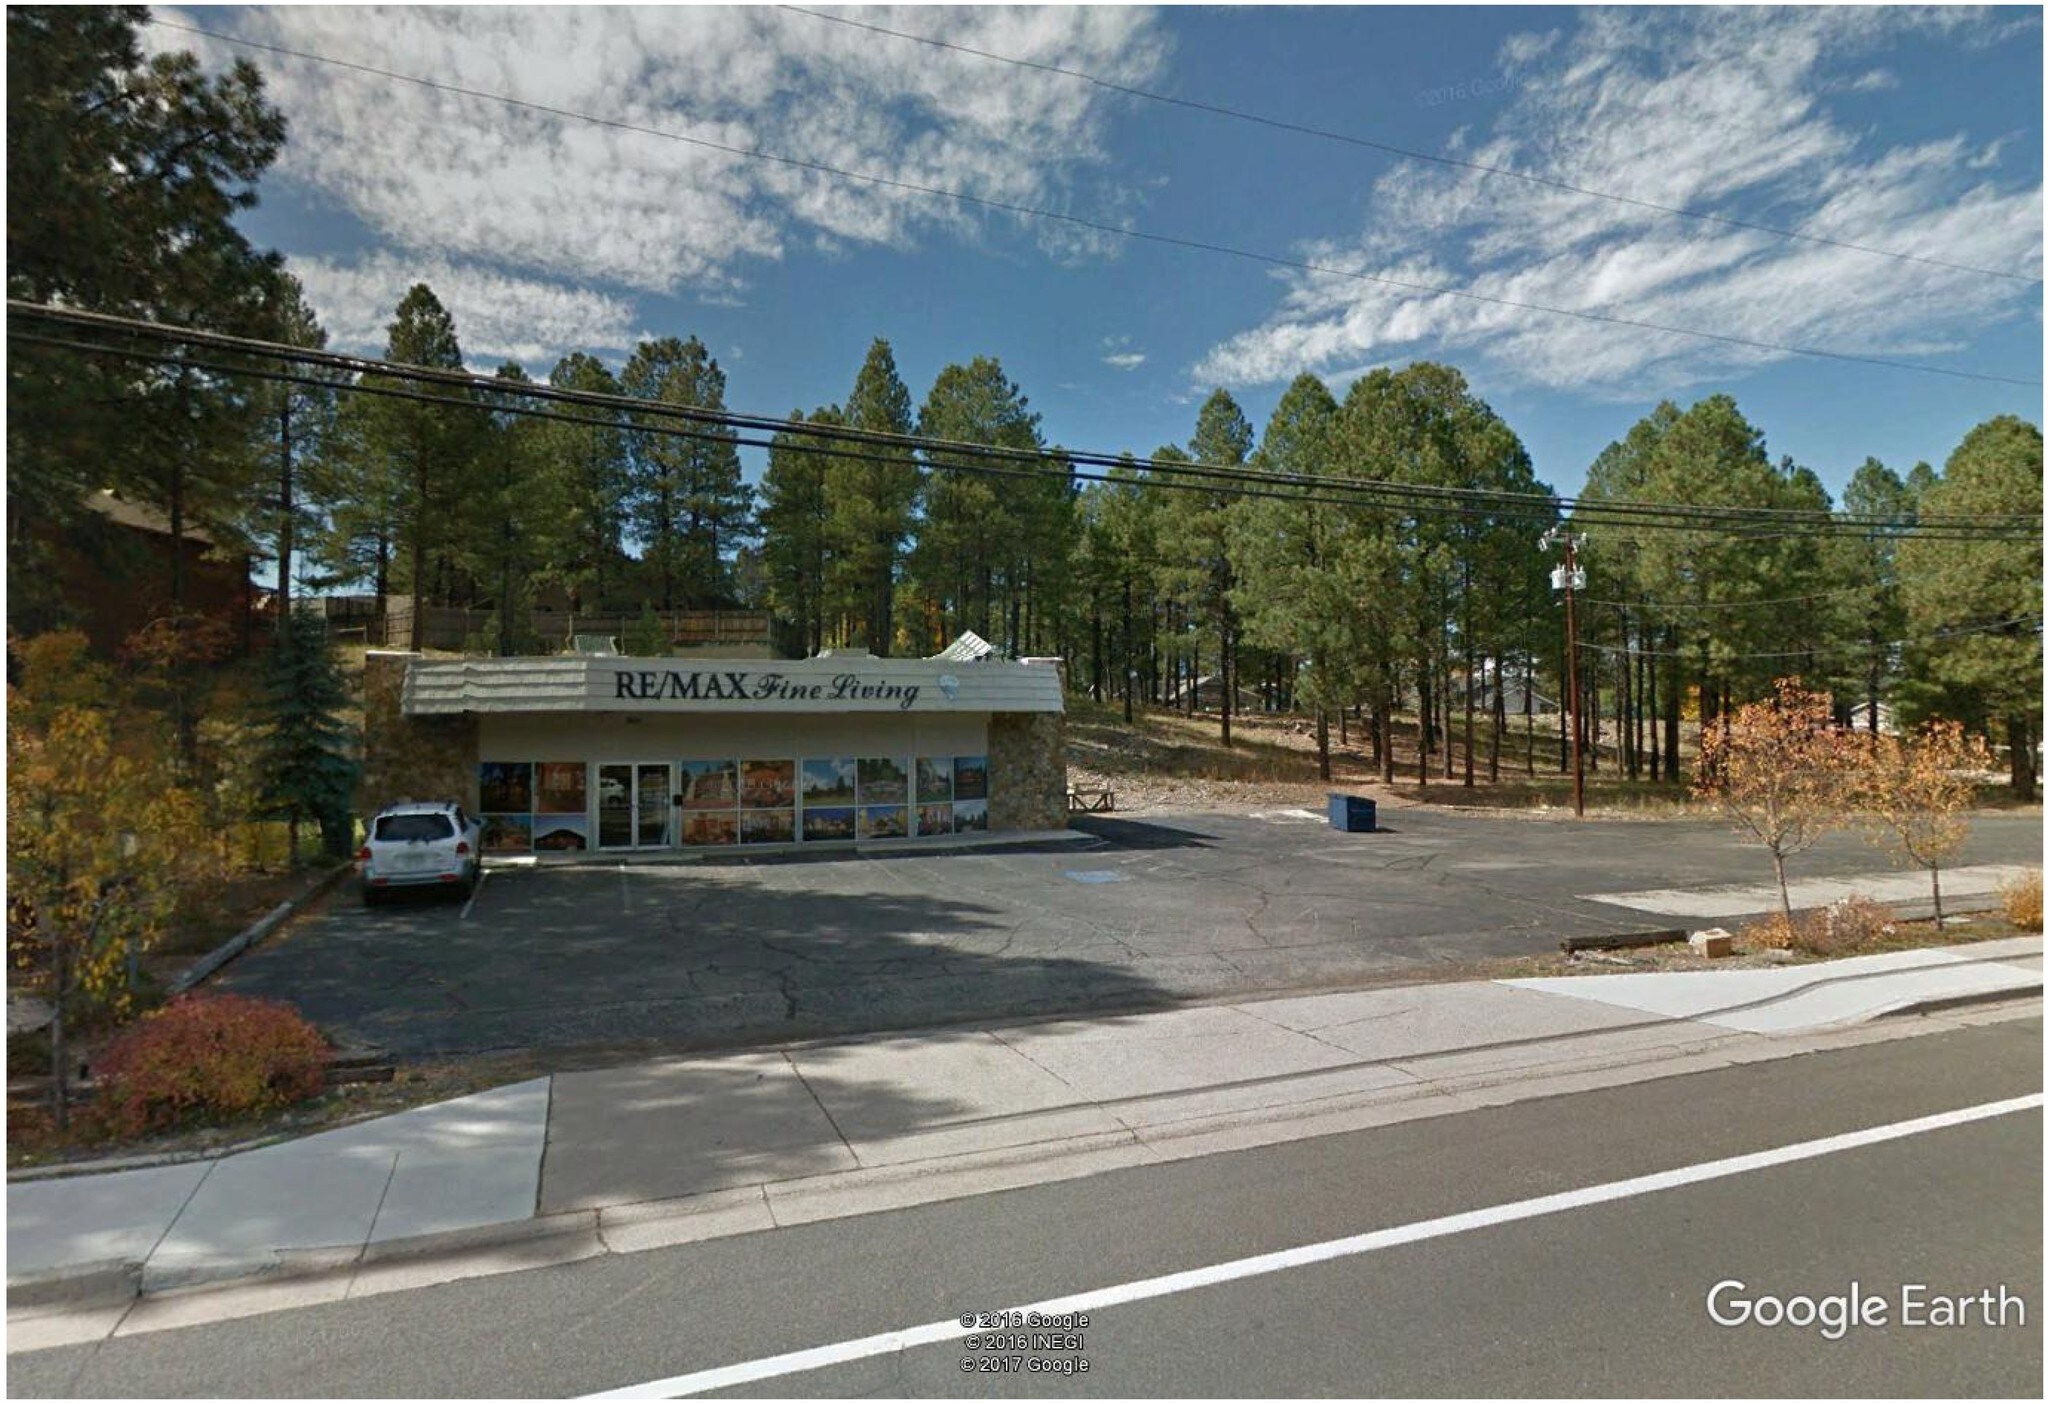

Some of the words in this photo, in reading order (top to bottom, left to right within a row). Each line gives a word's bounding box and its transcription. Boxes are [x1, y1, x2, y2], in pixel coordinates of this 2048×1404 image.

[614, 670, 752, 700] RE/MAX
[753, 673, 829, 701] Fine
[827, 673, 920, 709] Living
